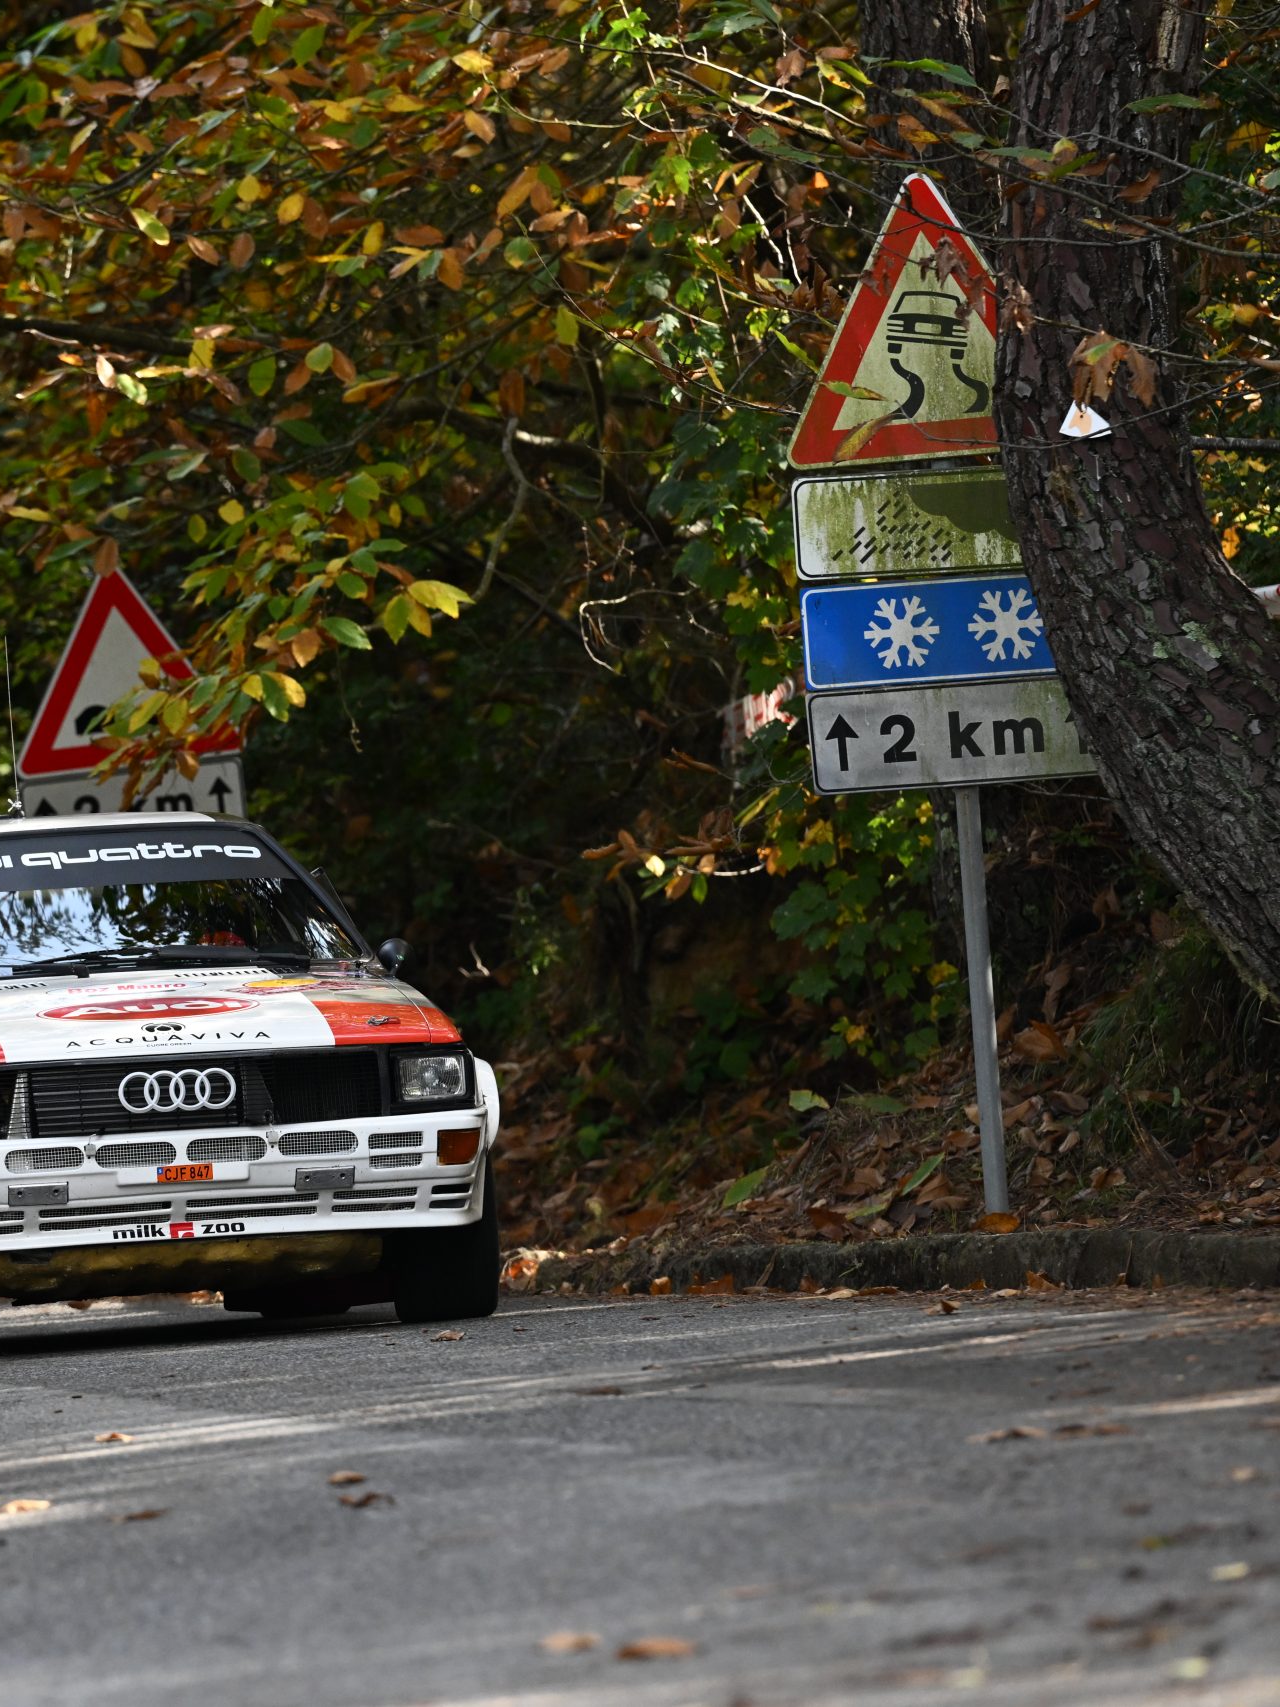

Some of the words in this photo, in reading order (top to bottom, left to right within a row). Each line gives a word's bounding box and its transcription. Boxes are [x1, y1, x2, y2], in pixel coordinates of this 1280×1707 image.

[879, 713, 917, 764] 2
[948, 711, 1045, 759] km
[20, 841, 262, 870] quattro
[116, 982, 187, 991] Mauro
[66, 1031, 271, 1049] ACQUAVIVA
[164, 1166, 187, 1181] CJF
[190, 1165, 211, 1179] 847
[112, 1224, 166, 1240] milk
[201, 1222, 246, 1235] zoo
